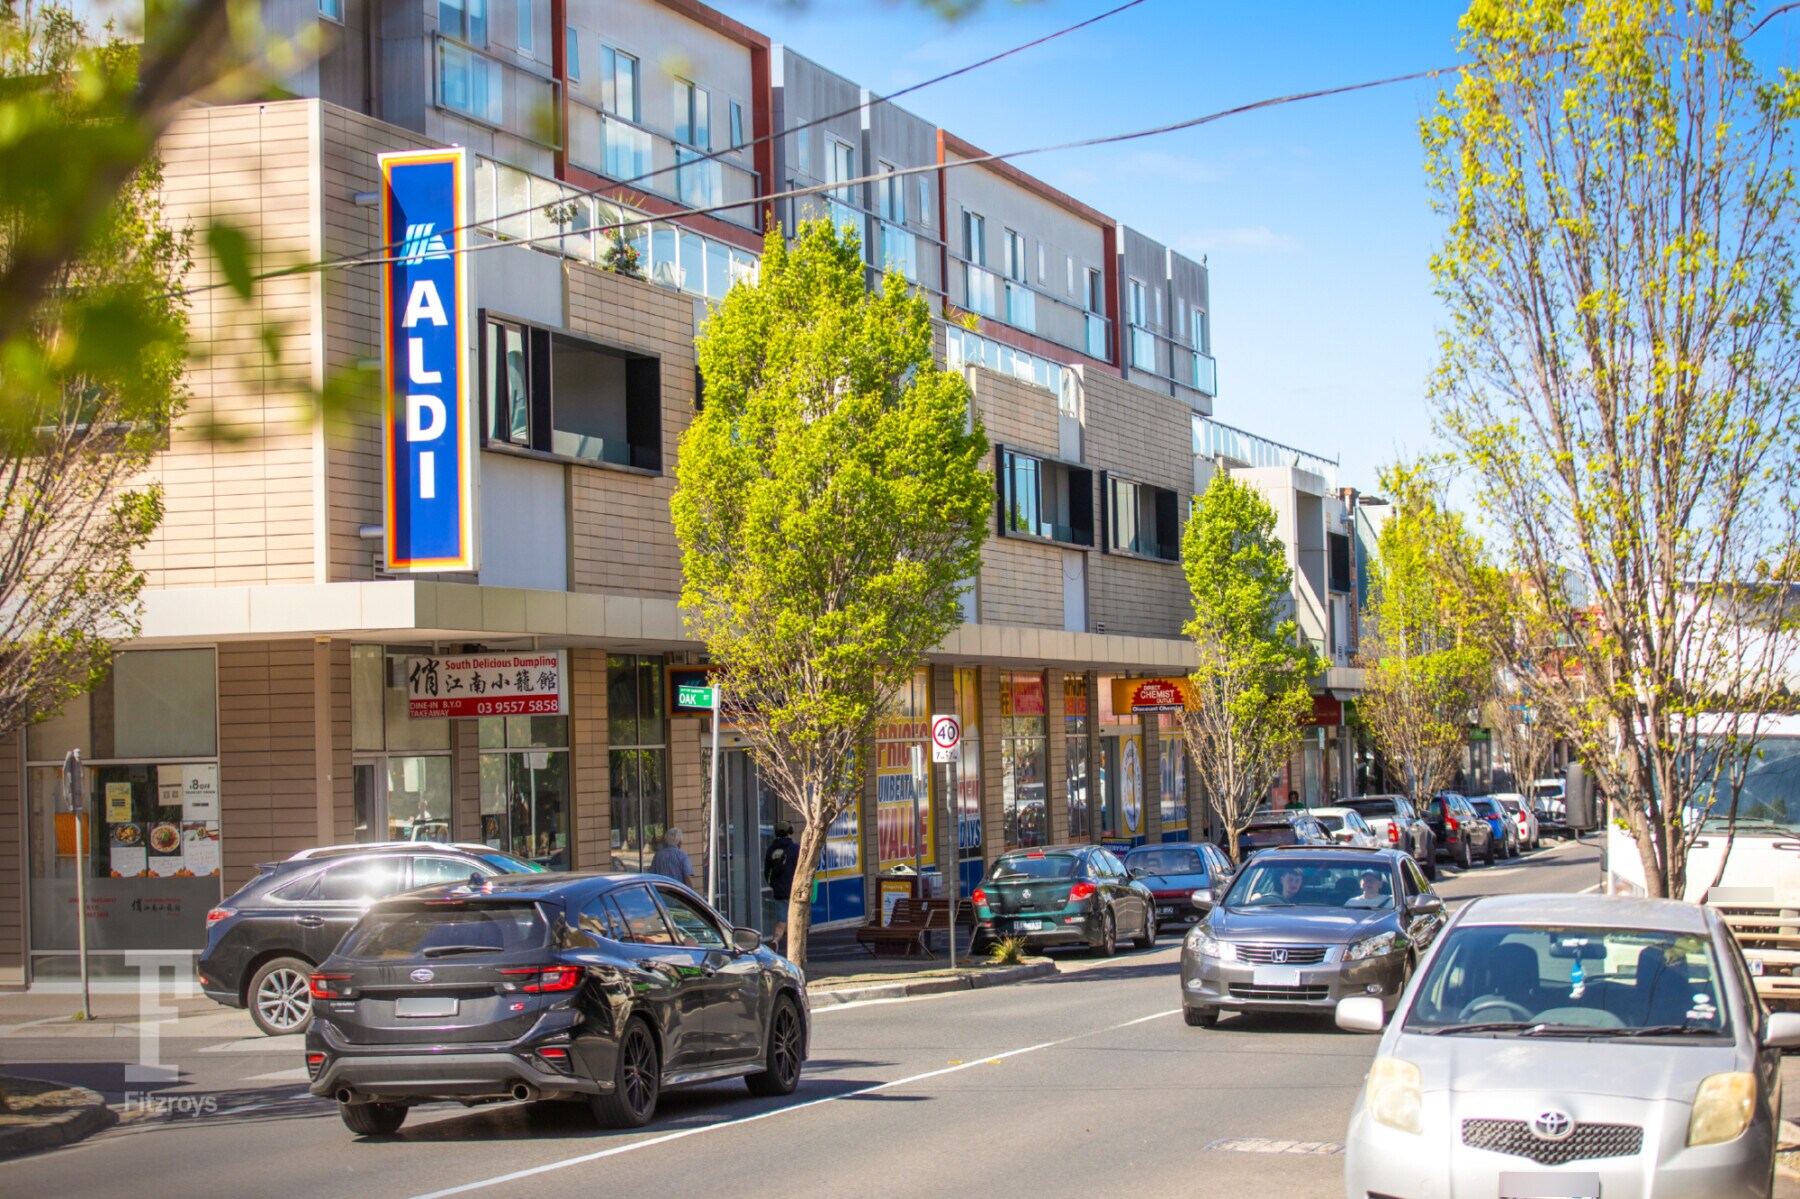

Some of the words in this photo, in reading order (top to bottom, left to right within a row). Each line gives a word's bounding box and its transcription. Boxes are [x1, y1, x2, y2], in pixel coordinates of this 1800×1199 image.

[402, 279, 449, 499] ALDI
[445, 660, 471, 670] South
[473, 657, 511, 669] Delicious
[513, 656, 557, 668] Dumpling
[679, 693, 697, 705] OAK
[1140, 690, 1175, 699] CHEMIST
[410, 700, 438, 710] DINE-IN
[477, 702, 493, 714] 03
[495, 701, 526, 713] 9557
[528, 699, 558, 712] 5858
[410, 709, 450, 718] TAKEAWAY
[937, 725, 956, 740] 40
[877, 722, 929, 769] PRICS
[877, 772, 929, 804] UNBEATALE
[959, 818, 981, 848] DAYS
